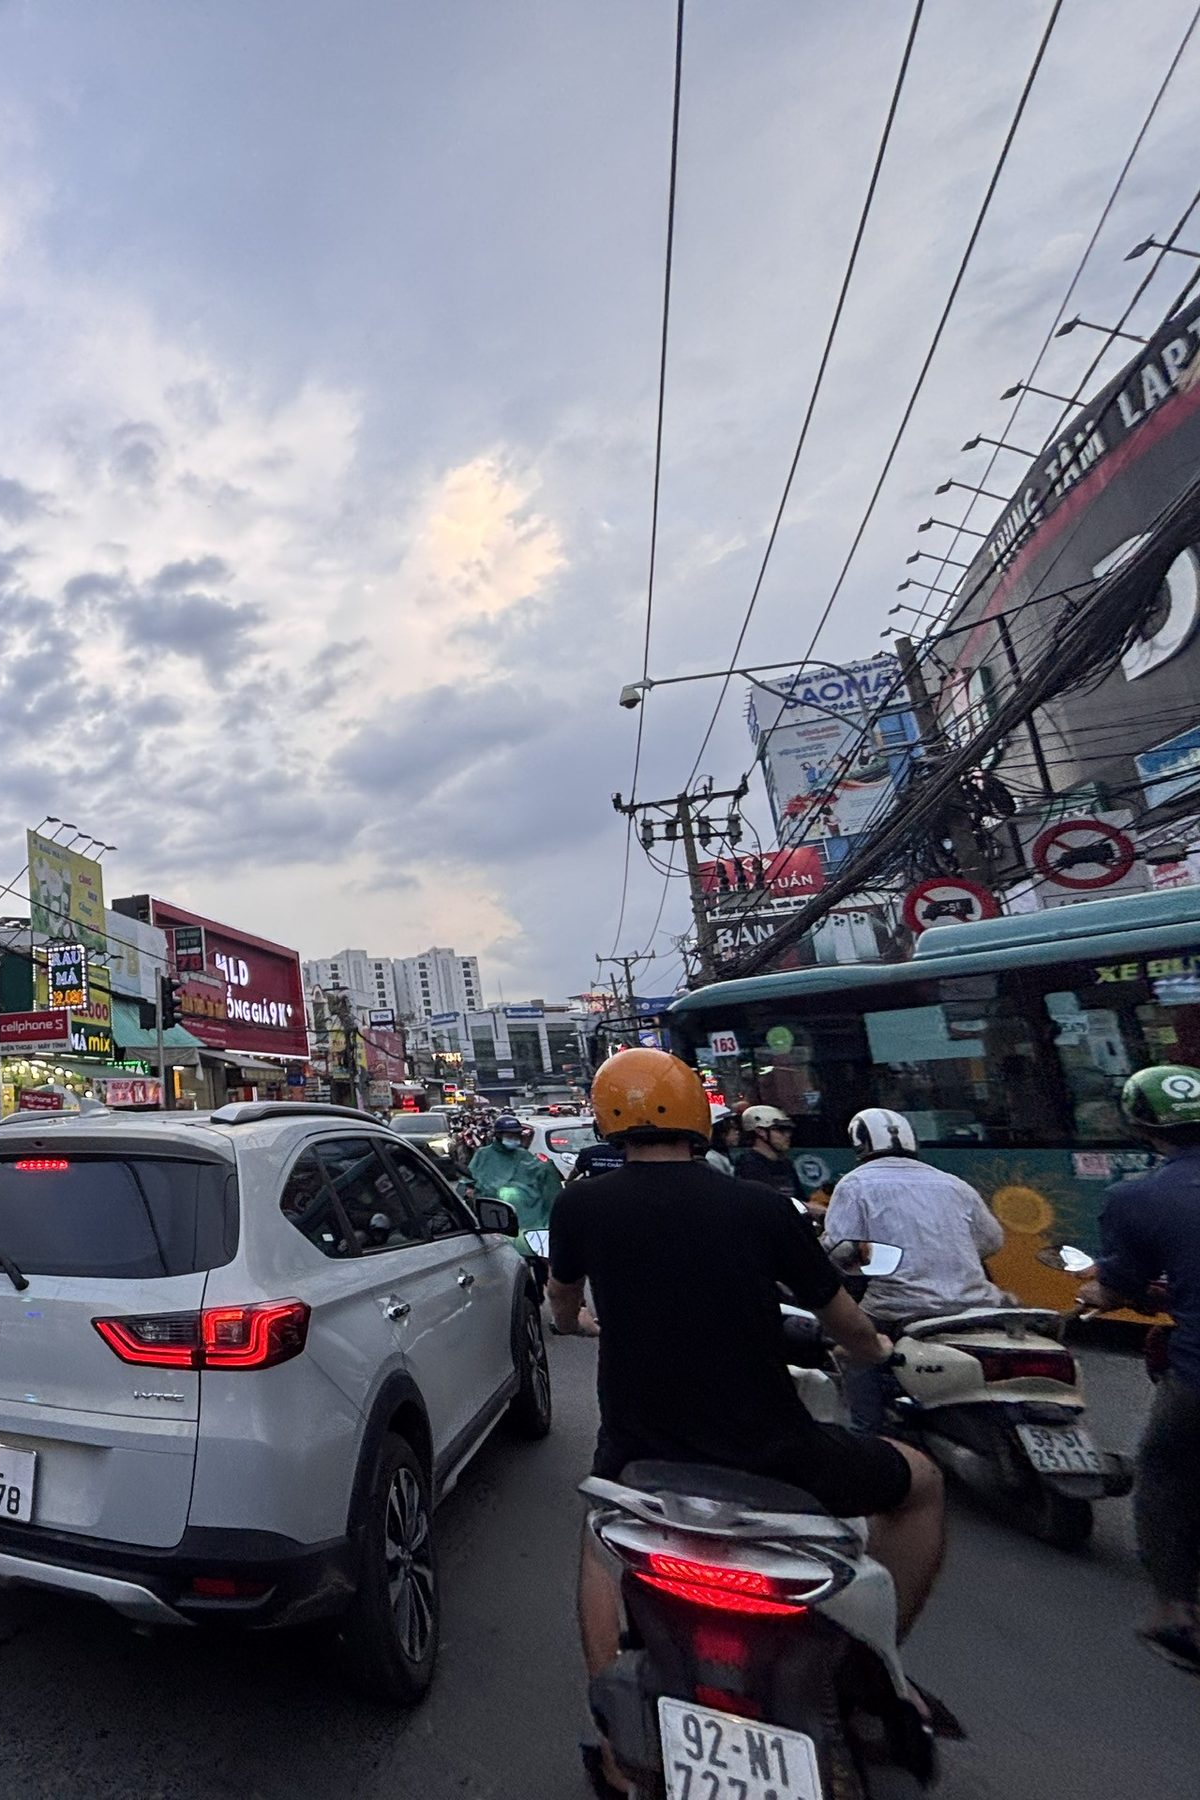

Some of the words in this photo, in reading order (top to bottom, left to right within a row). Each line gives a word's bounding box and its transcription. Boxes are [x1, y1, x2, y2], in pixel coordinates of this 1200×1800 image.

[52, 950, 81, 967] RAU
[55, 966, 79, 985] MÁ
[1095, 963, 1139, 984] XE
[88, 1031, 110, 1052] mix
[712, 1037, 737, 1053] 163
